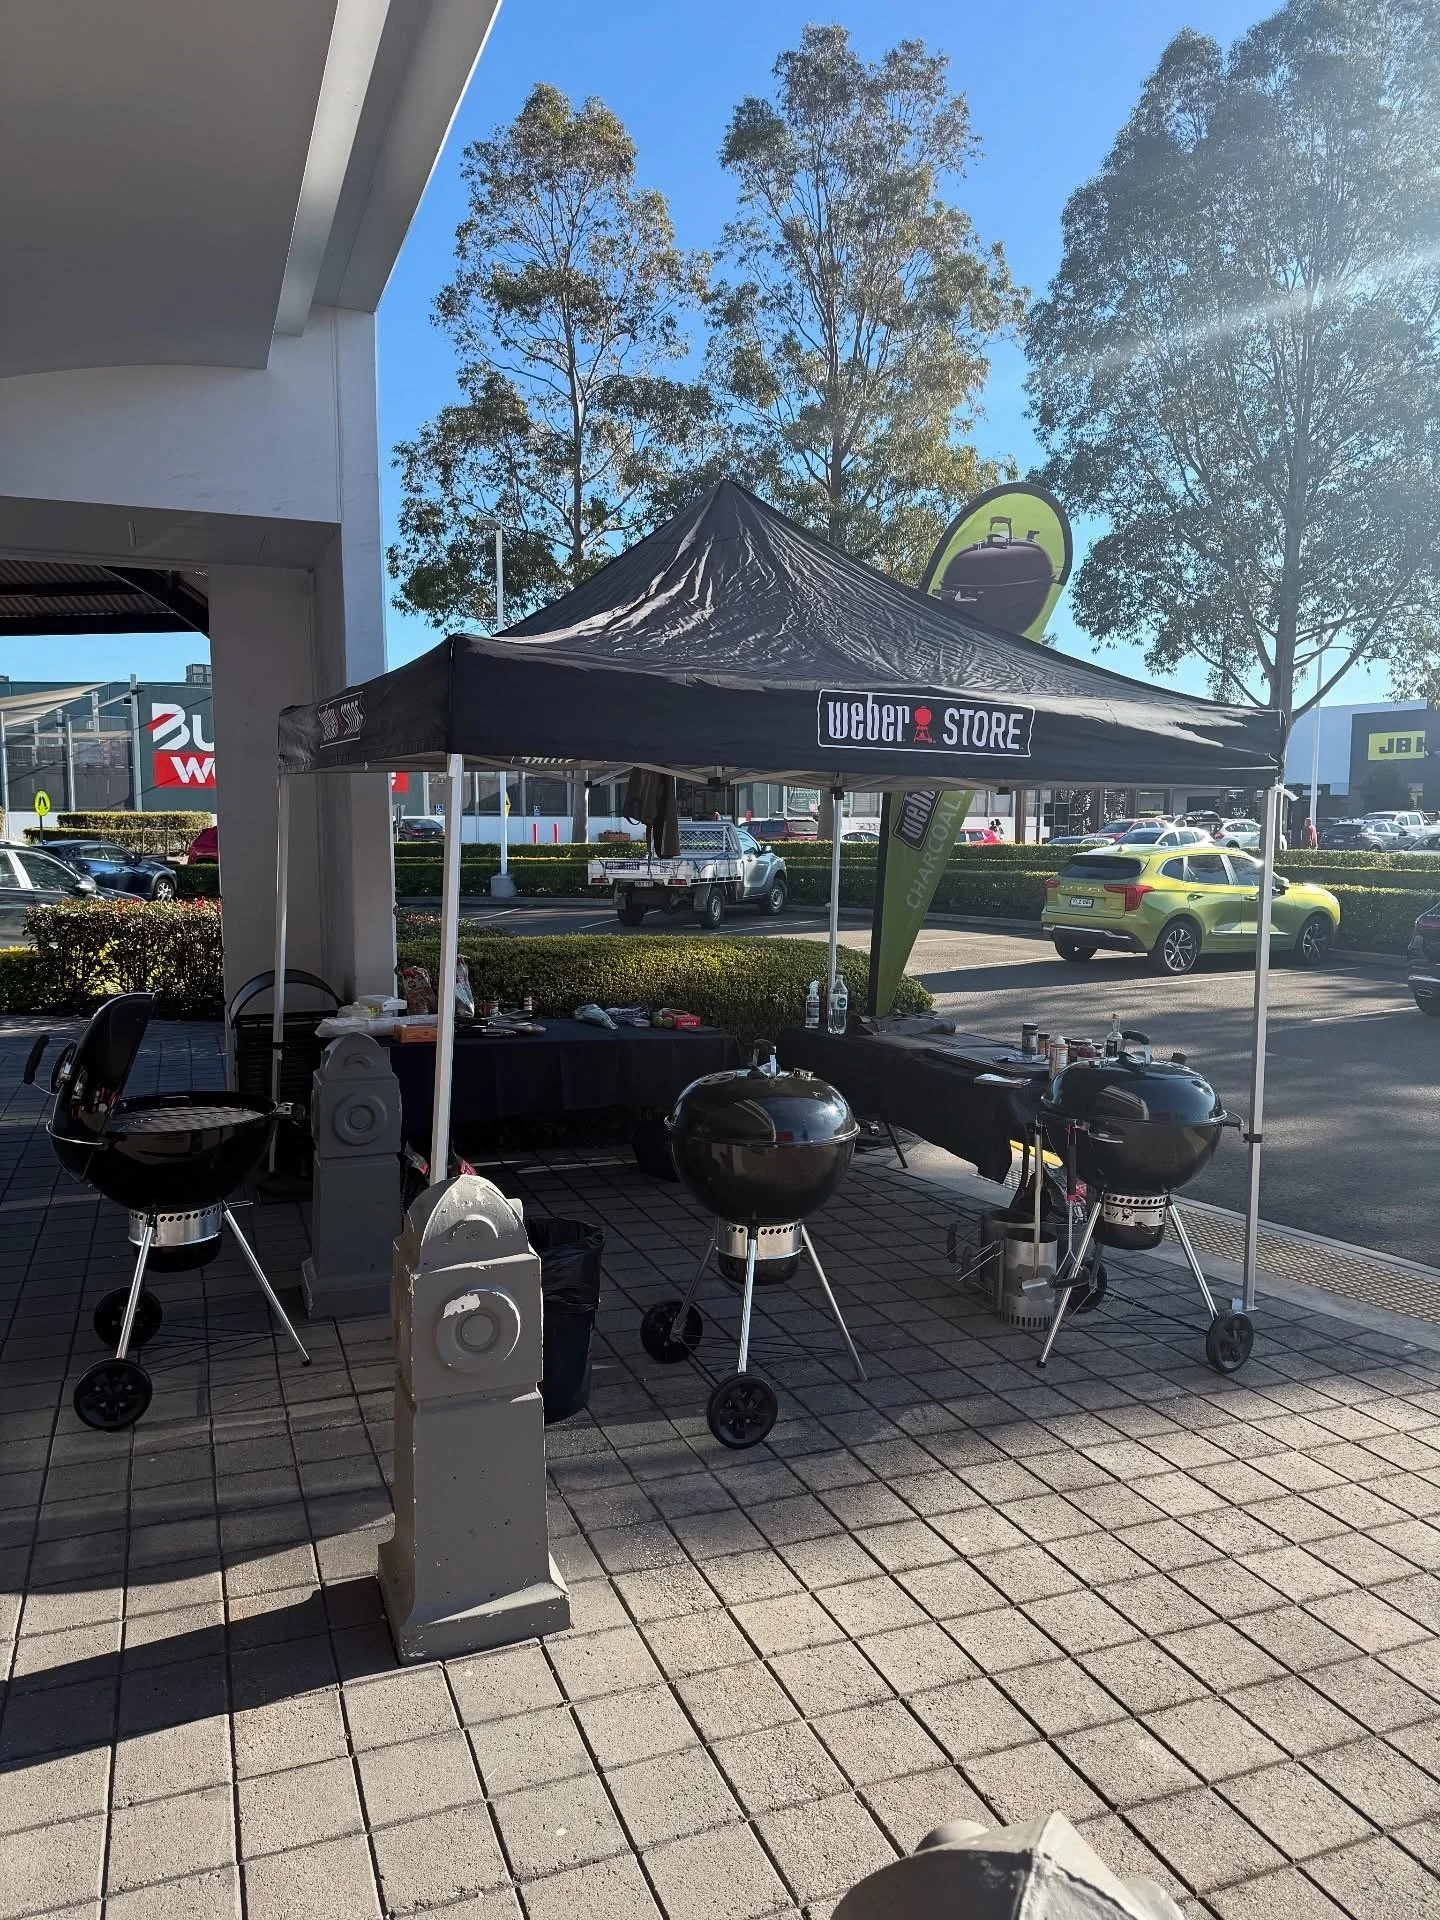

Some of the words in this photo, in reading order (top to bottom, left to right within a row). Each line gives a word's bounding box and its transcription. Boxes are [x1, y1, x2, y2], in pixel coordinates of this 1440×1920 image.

[827, 694, 910, 742] weber
[942, 708, 1023, 750] STORE
[170, 756, 215, 784] W
[907, 798, 962, 909] CHARCOAL
